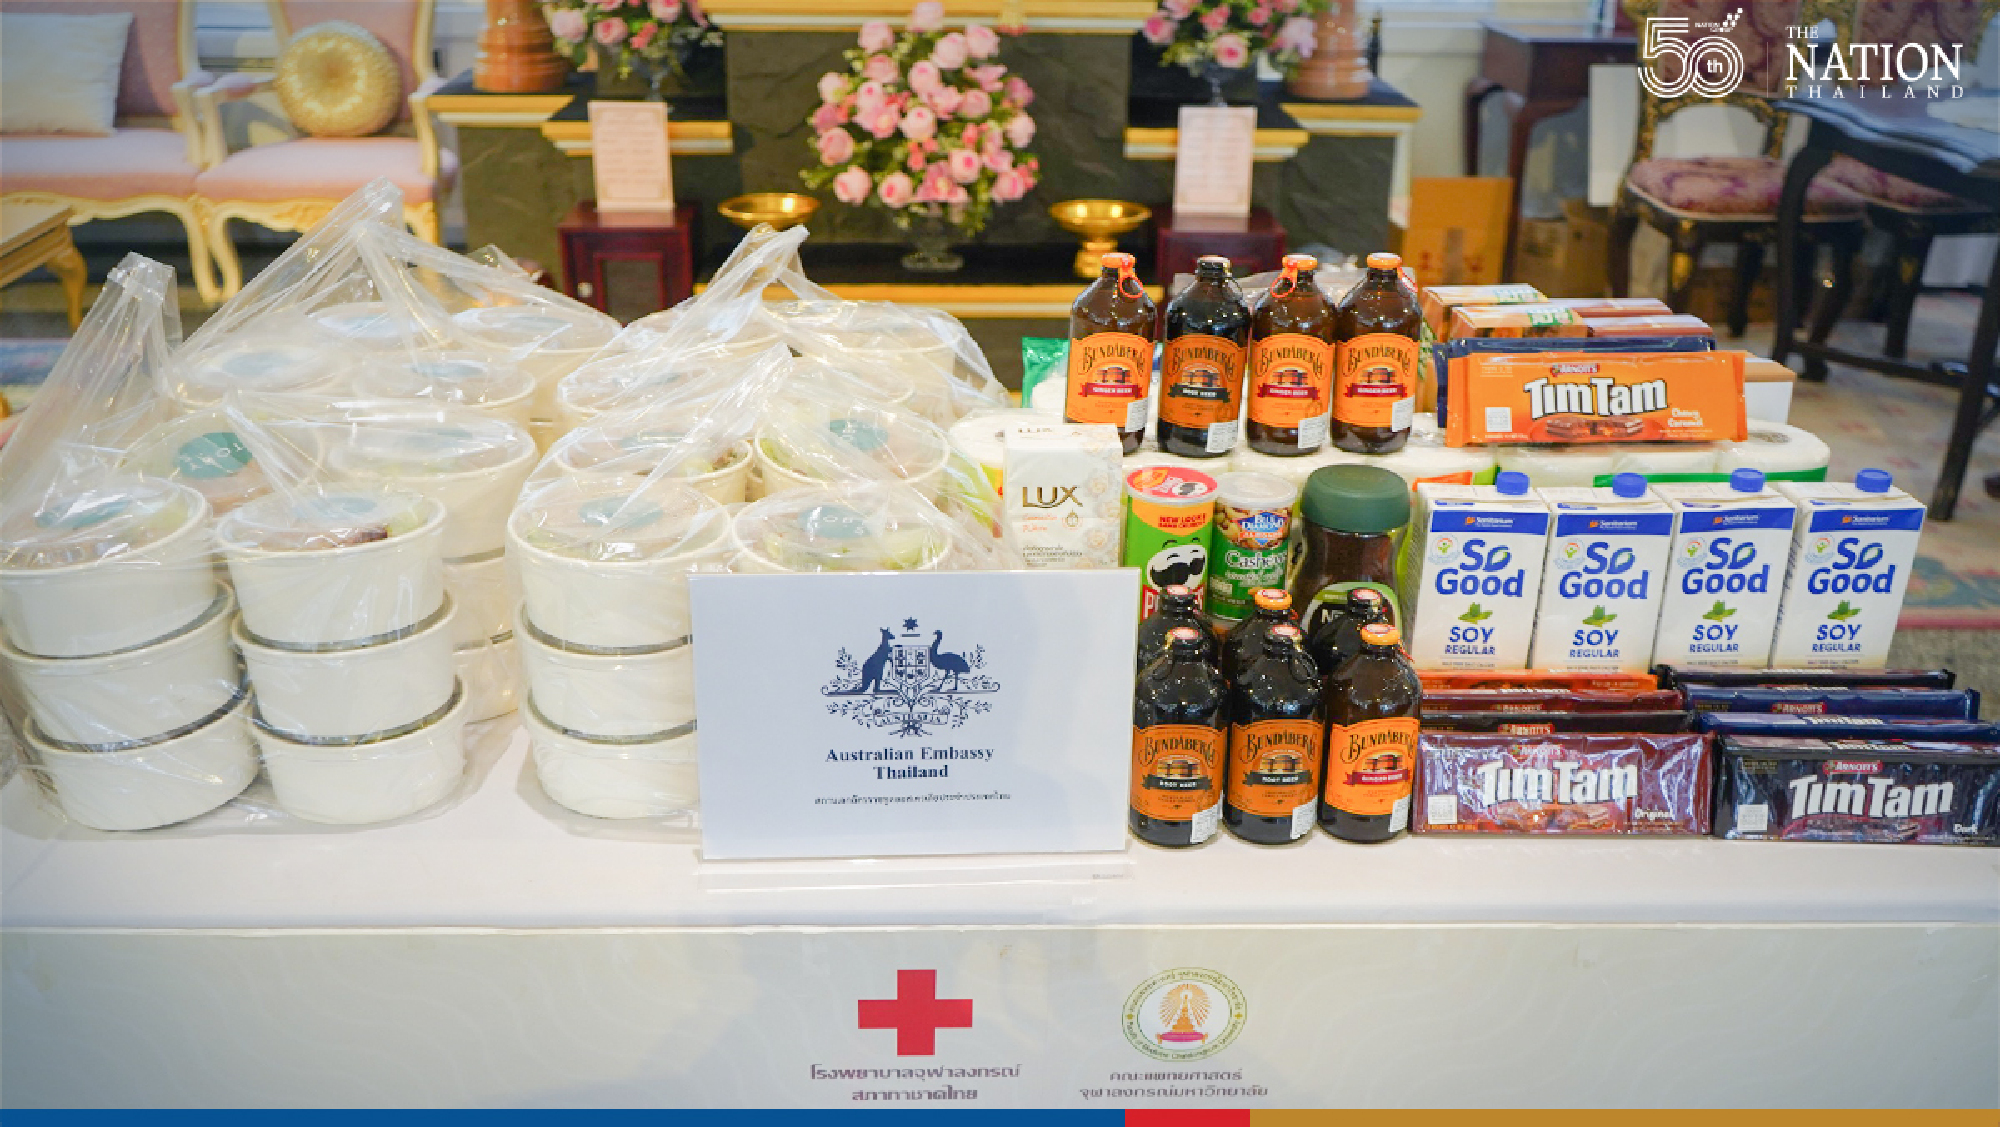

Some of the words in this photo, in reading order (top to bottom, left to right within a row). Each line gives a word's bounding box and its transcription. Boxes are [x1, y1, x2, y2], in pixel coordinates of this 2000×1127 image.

[1022, 486, 1083, 509] LUX
[1459, 538, 1512, 572] So
[1582, 541, 1636, 575] So
[1705, 537, 1757, 570] So
[1832, 537, 1883, 571] So
[1435, 568, 1525, 598] Good
[1559, 569, 1649, 600] Good
[1681, 564, 1771, 595] Good
[1807, 564, 1896, 595] Good
[1449, 626, 1495, 643] SOY
[1572, 629, 1619, 646] SOY
[1693, 624, 1739, 641] SOY
[1816, 624, 1862, 641] SOY
[1445, 645, 1496, 656] REGULAR
[1569, 648, 1620, 658] REGULAR
[1689, 643, 1739, 653] REGULAR
[1812, 643, 1861, 653] REGULAR
[825, 746, 914, 762] Australian
[920, 746, 995, 762] Embassy
[1139, 735, 1219, 769] BUNDABERG
[1239, 730, 1318, 764] BUNDABERG
[872, 764, 949, 780] Thailand
[810, 1063, 1022, 1083] โรงพยาบาลจุฬาลงกรณ์
[1109, 1069, 1243, 1082] คณะแพทยศาสตร์
[851, 1084, 979, 1101] สภากาชาดไทย
[1078, 1084, 1269, 1099] จุฬาลงกรณ์มหาวิทยาลัย
